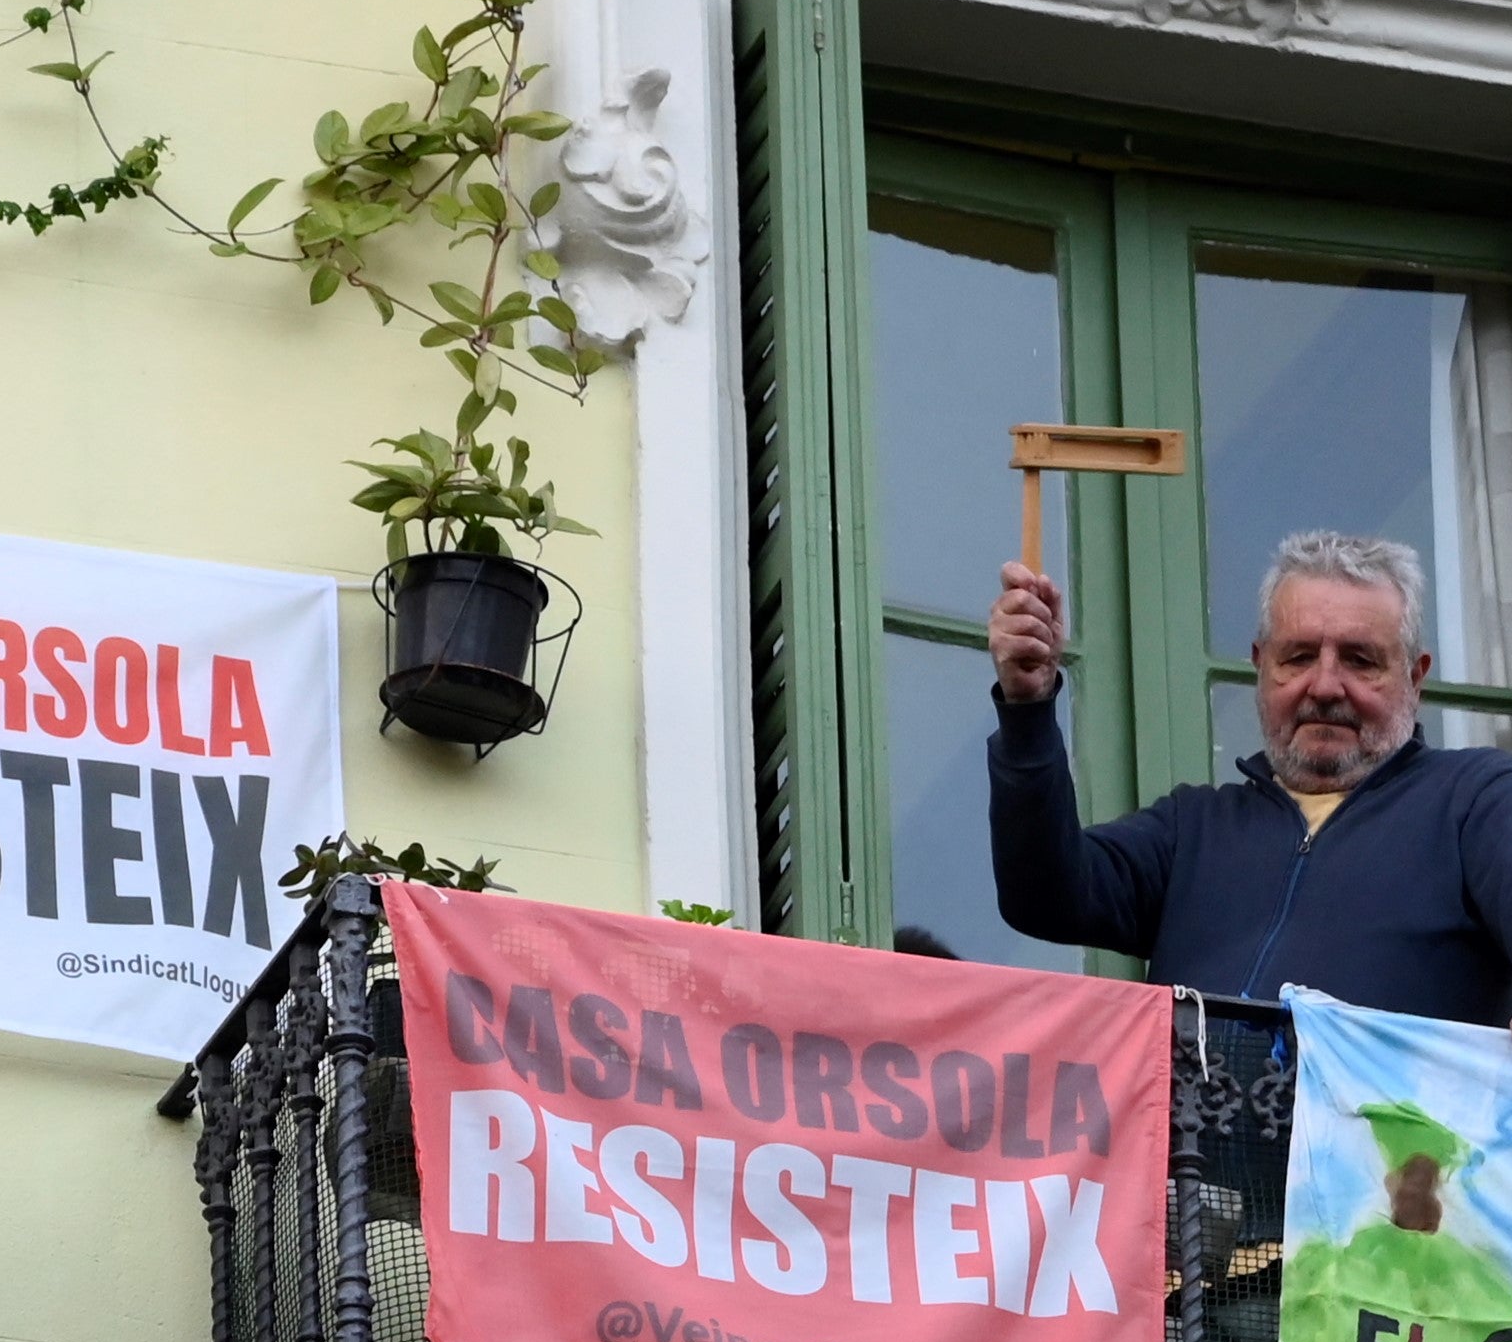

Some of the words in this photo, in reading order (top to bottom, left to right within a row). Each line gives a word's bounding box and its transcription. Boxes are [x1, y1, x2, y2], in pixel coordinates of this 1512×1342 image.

[445, 969, 705, 1112] CASA
[721, 1024, 1112, 1160] ORSOLA
[449, 1089, 1120, 1319] RESISTEIX
